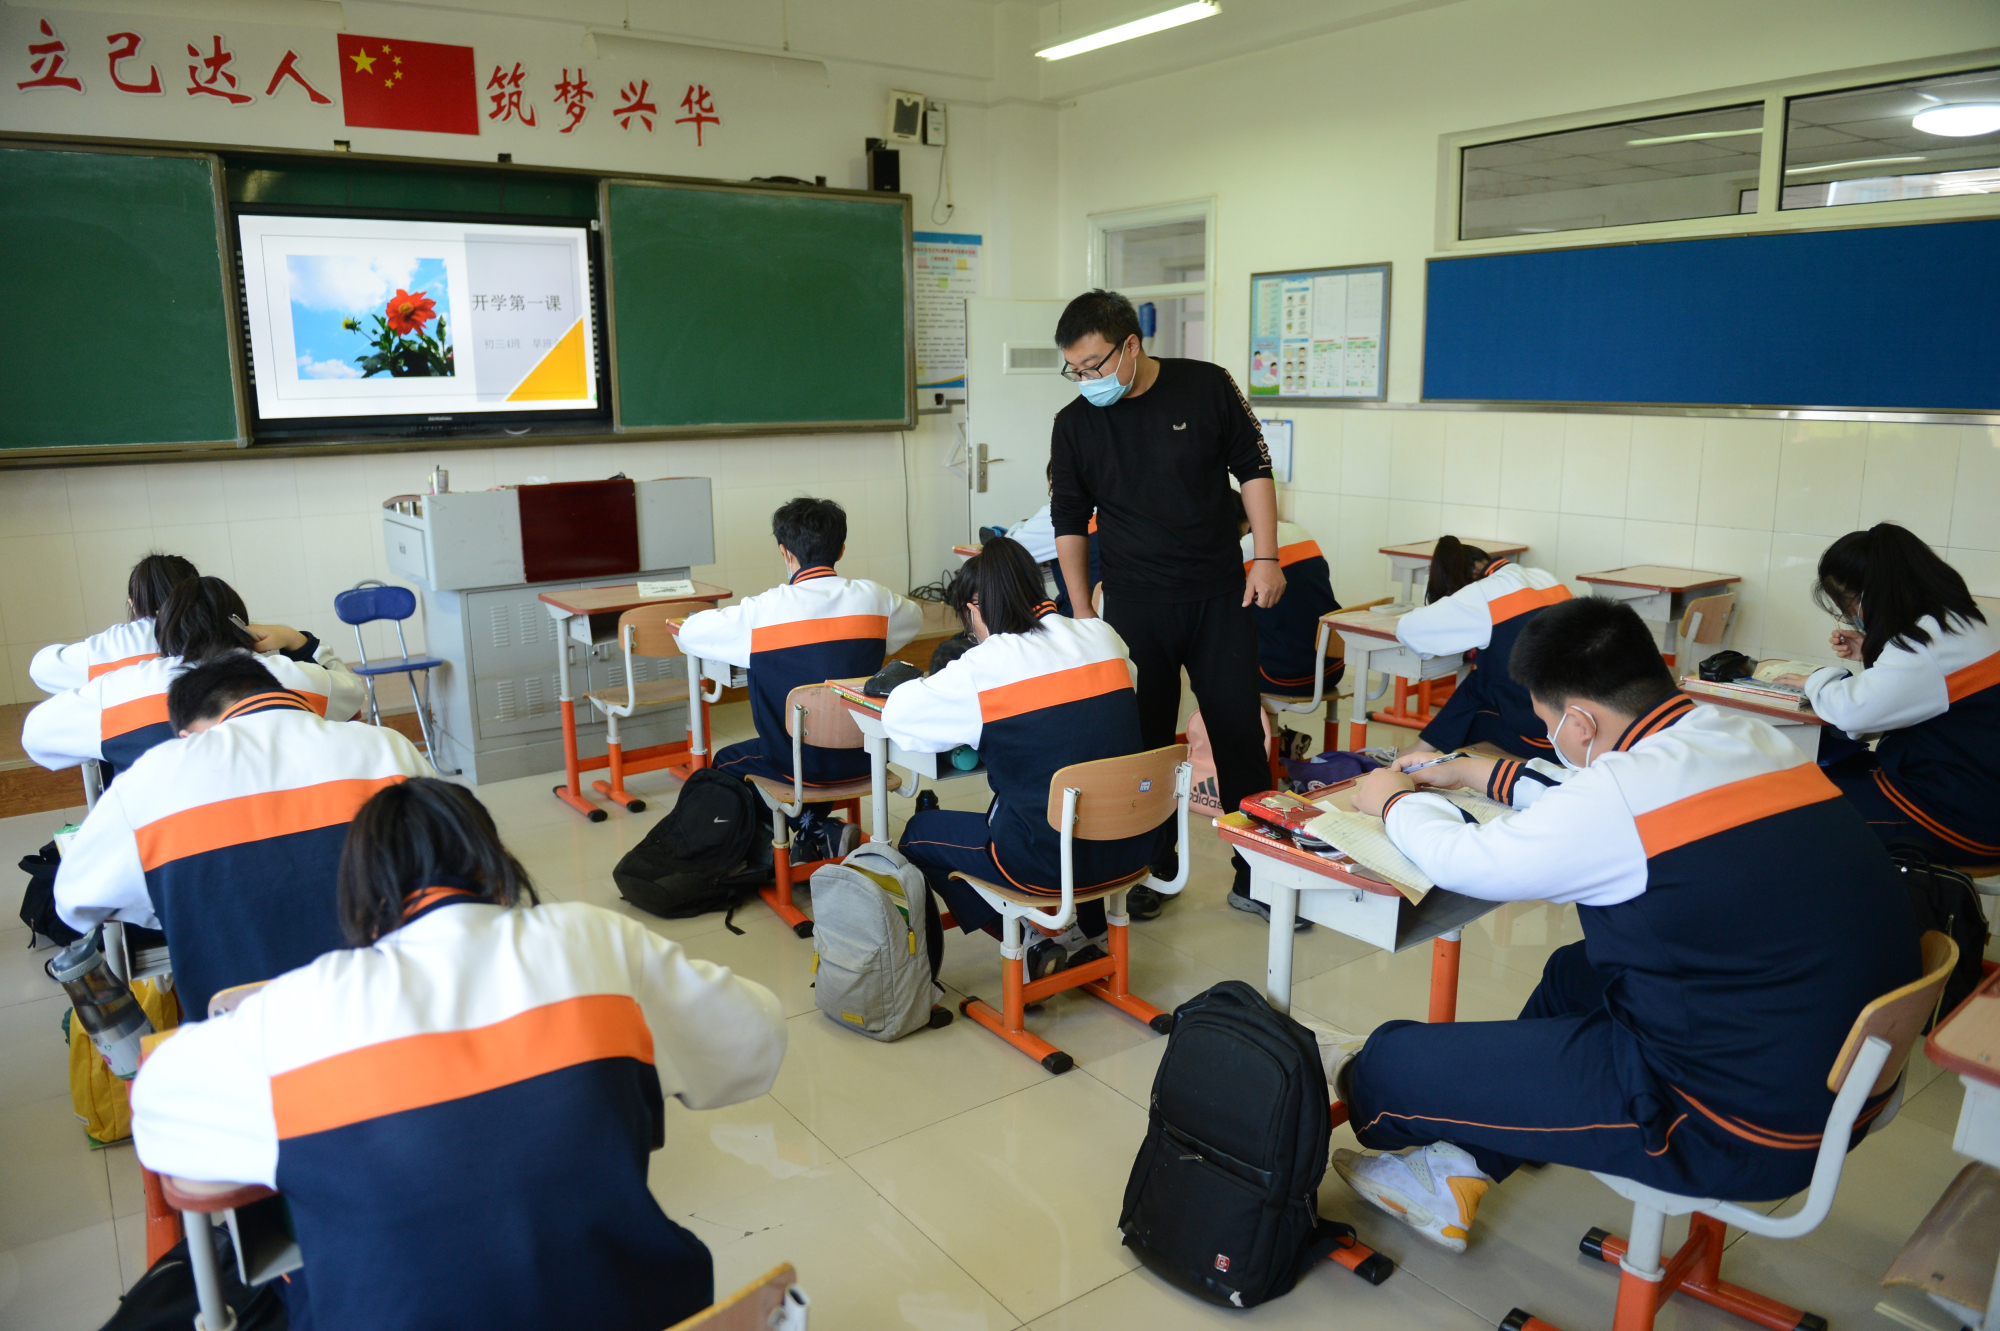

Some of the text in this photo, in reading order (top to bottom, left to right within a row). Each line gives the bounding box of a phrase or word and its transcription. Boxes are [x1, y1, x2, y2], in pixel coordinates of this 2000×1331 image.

[17, 19, 721, 147] 立己达人 筑梦兴华
[472, 294, 562, 312] 开学第一课
